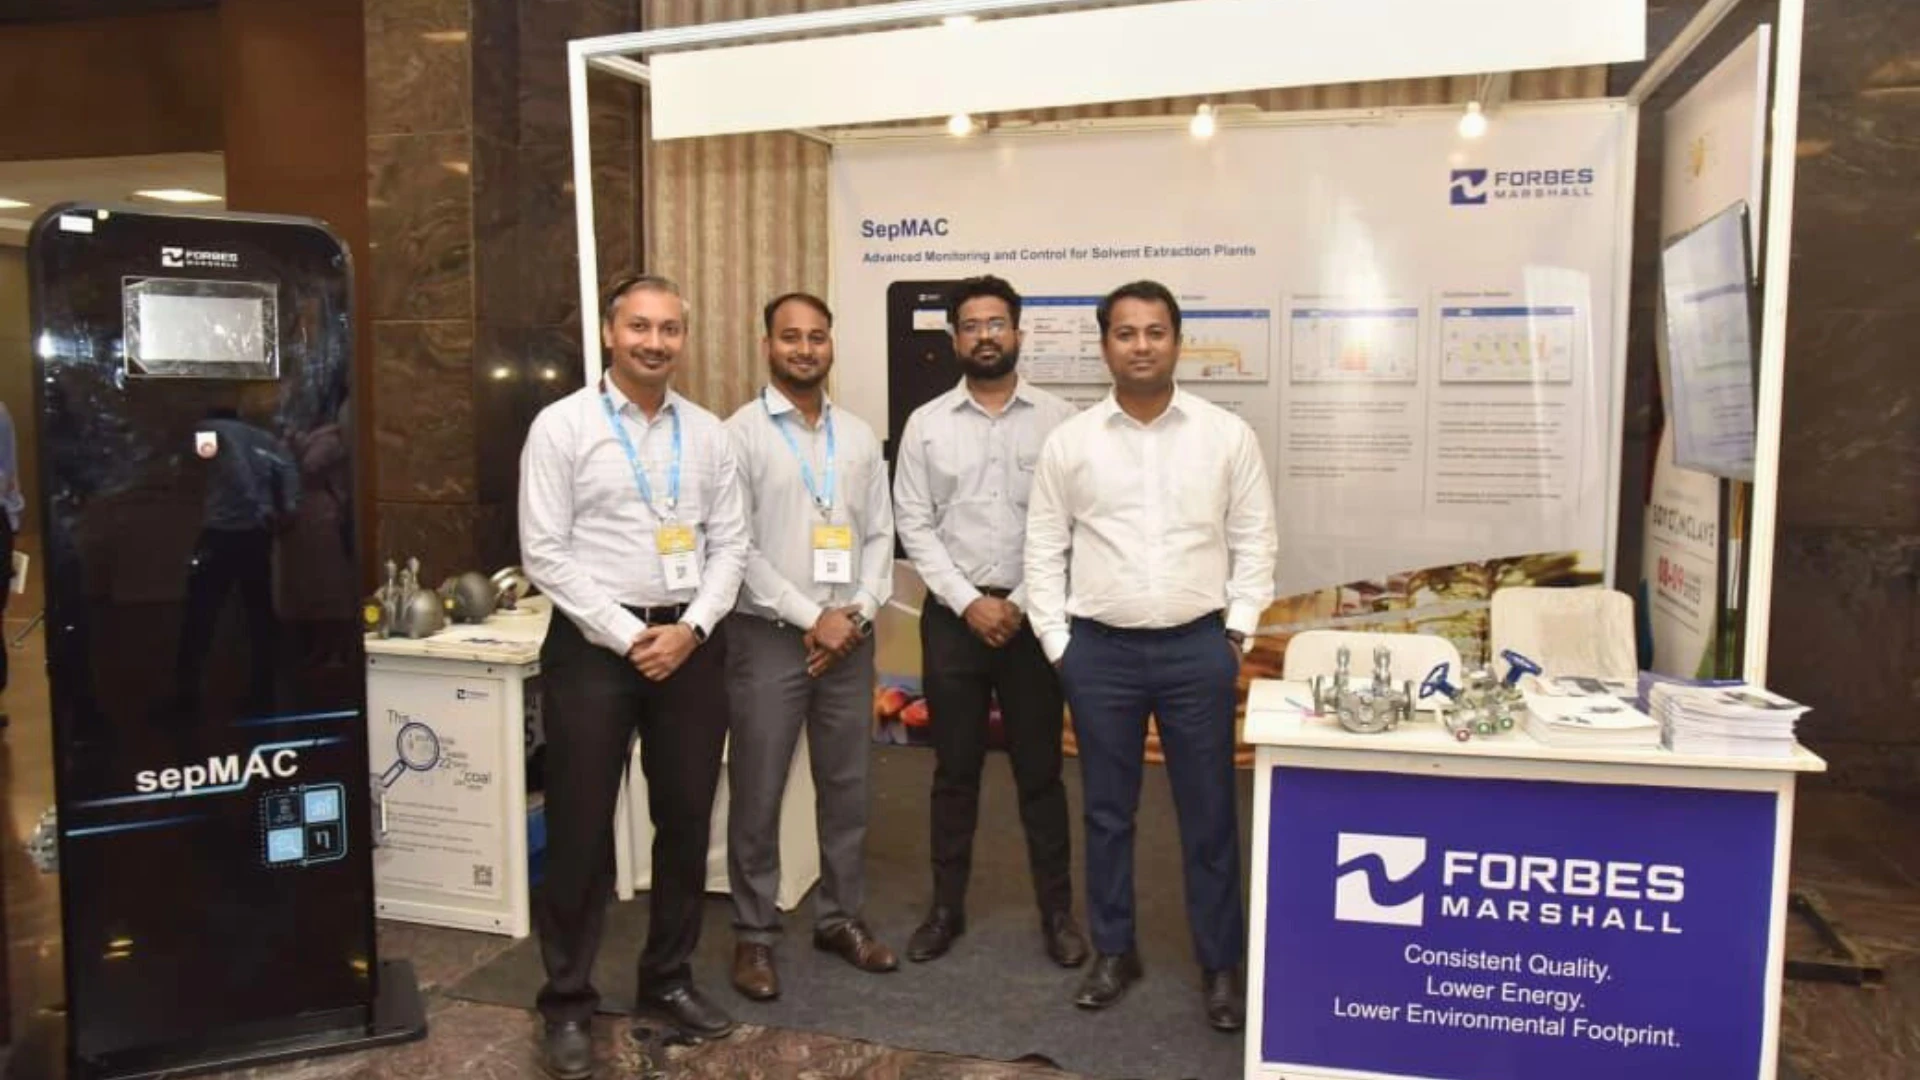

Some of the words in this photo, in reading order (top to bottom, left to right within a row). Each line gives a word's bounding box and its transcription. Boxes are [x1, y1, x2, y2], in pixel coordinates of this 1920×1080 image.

[1493, 188, 1594, 199] MARSHALL
[1494, 168, 1594, 186] FORBES
[861, 218, 949, 241] SepMAC
[185, 251, 238, 262] FORBES
[863, 251, 922, 263] Advanced
[925, 250, 990, 263] Monitoring
[994, 249, 1017, 261] and
[1020, 248, 1066, 261] Control
[1070, 247, 1088, 259] for
[1092, 247, 1140, 259] Solvent
[1144, 245, 1211, 258] Extraction
[1214, 244, 1256, 257] Plants
[136, 750, 299, 795] sepMAC
[1443, 850, 1685, 902] FORBES
[1441, 895, 1683, 934] MARSHALL
[1404, 943, 1522, 973] Consistent
[1528, 953, 1612, 984] Quality.
[1426, 975, 1496, 1000] Lower
[1501, 982, 1586, 1012] Energy.
[1333, 996, 1400, 1021] Lower
[1406, 1003, 1566, 1037] Environmental
[1573, 1018, 1681, 1048] Footprint.
